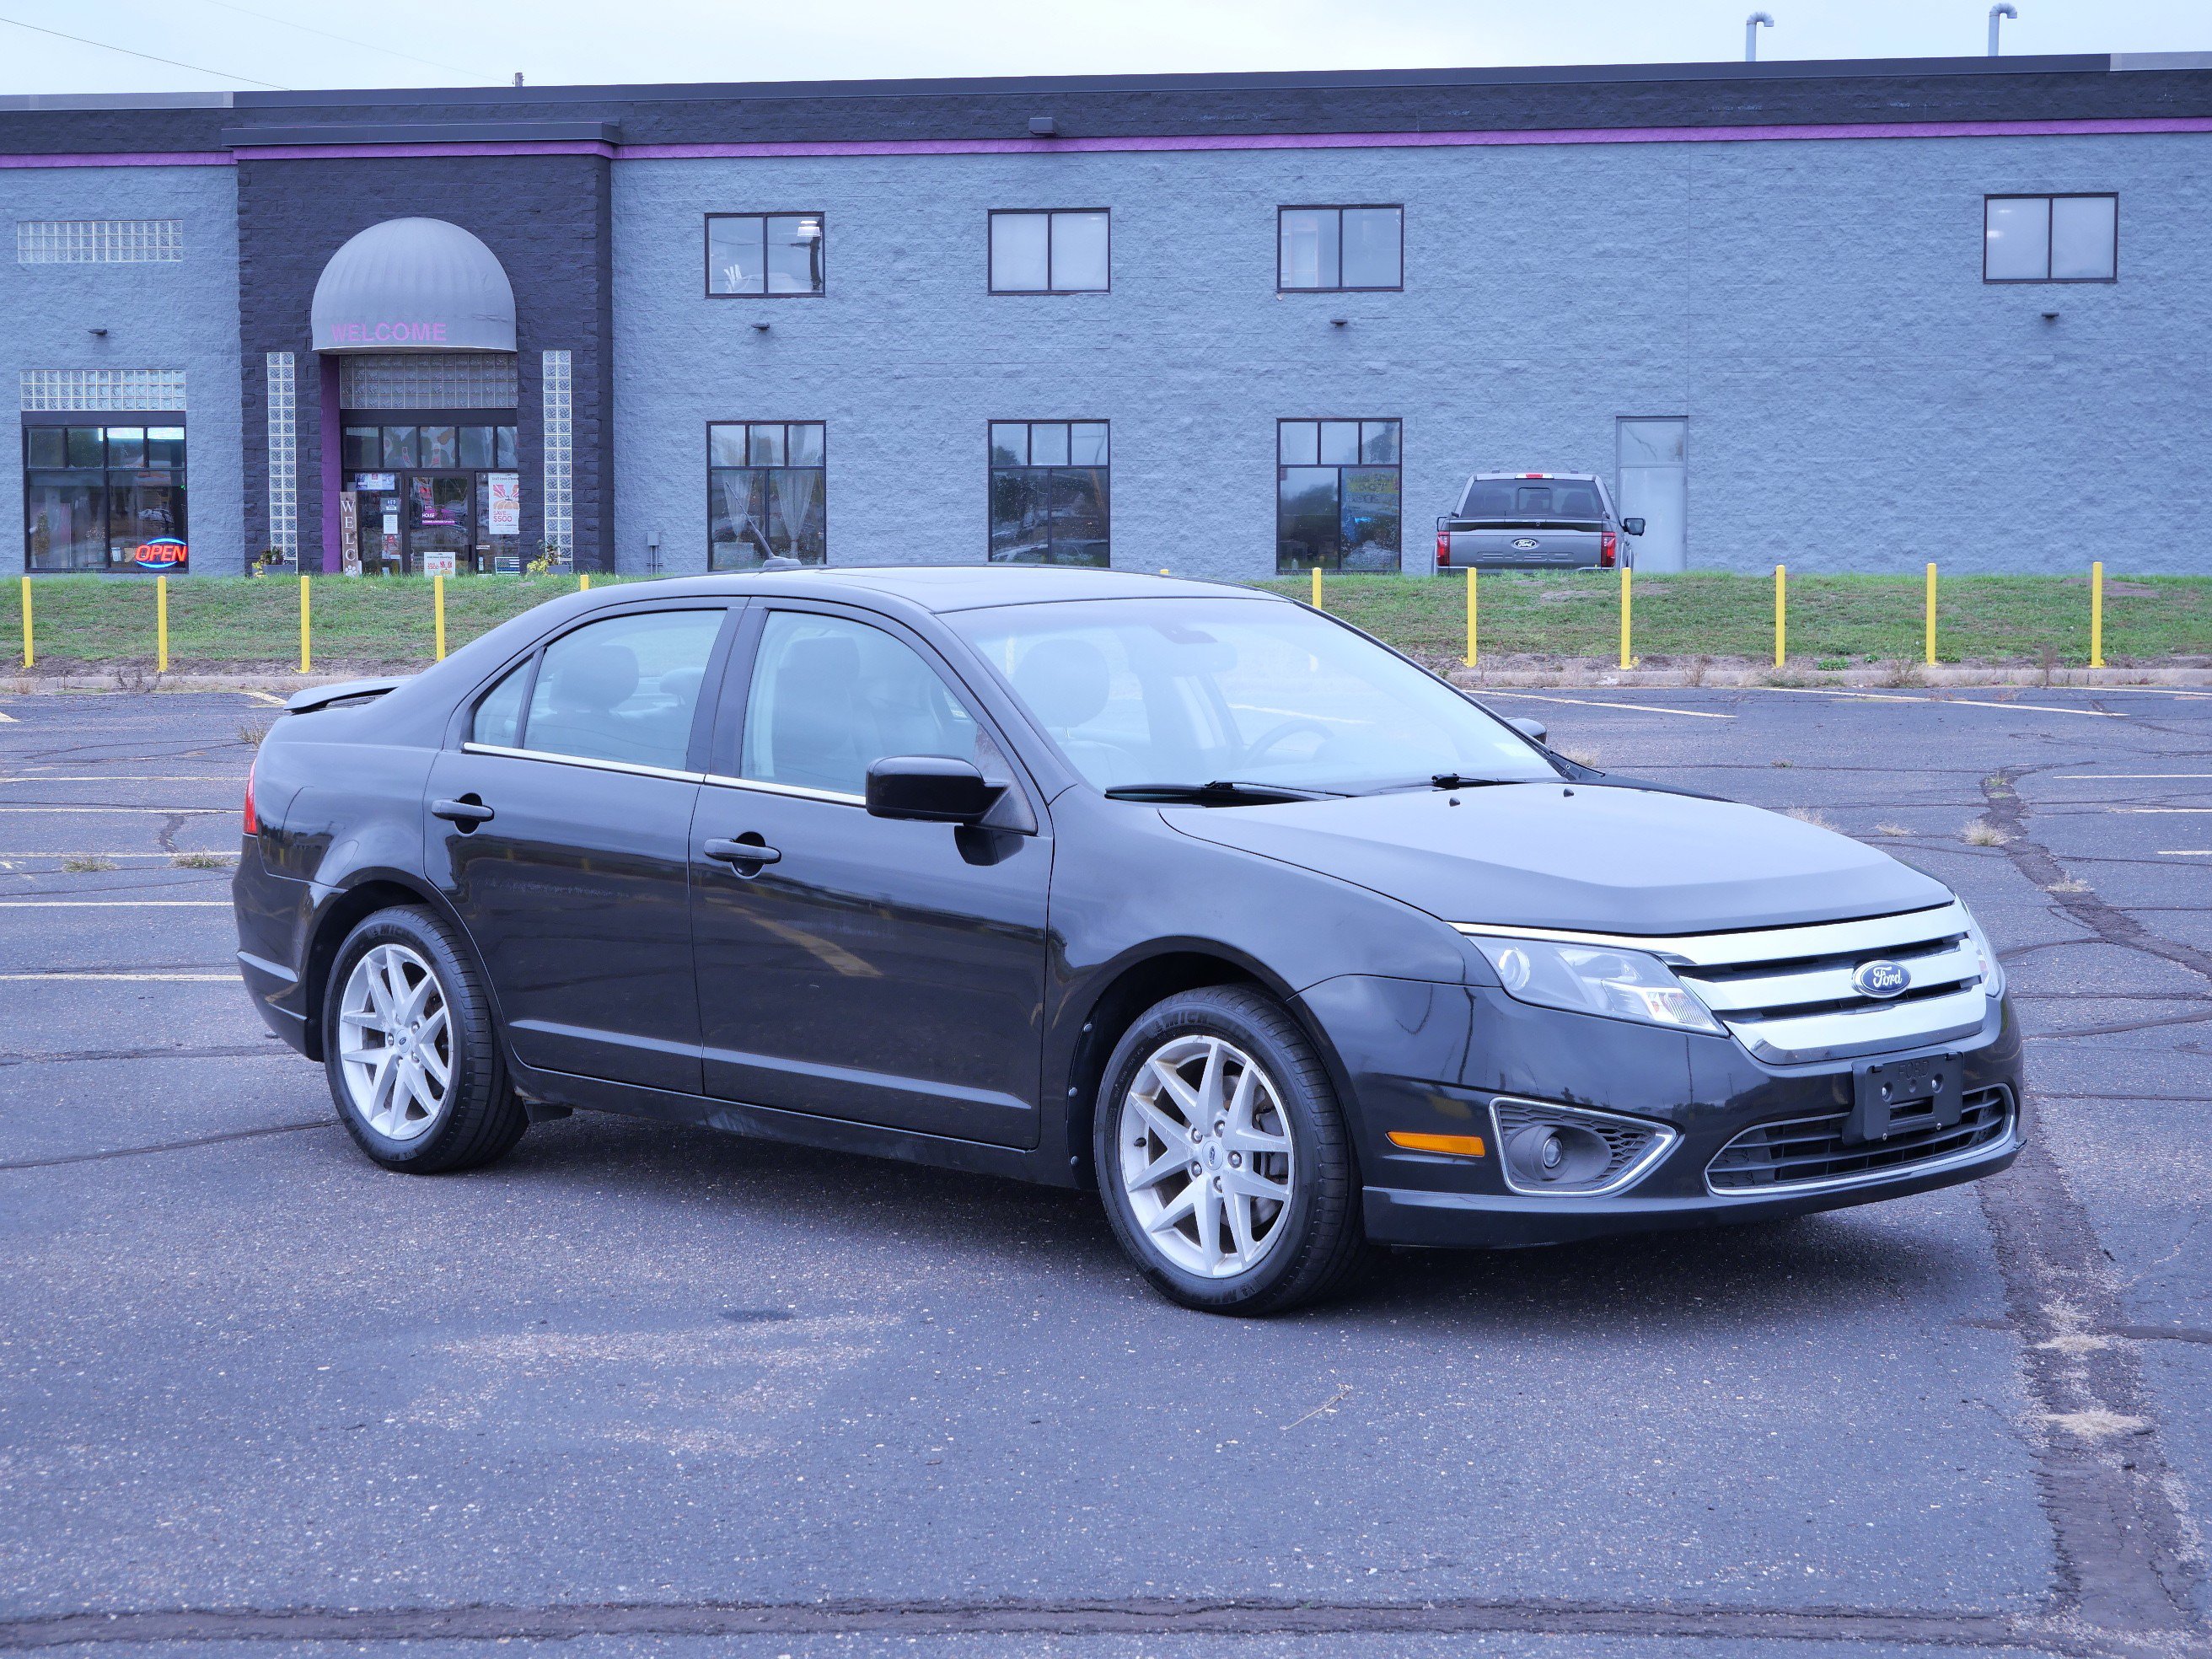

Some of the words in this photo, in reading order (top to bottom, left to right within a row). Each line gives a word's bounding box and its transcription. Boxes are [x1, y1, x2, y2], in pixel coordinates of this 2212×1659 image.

[330, 322, 447, 341] WELCOME
[135, 544, 188, 562] OPEN
[1872, 966, 1903, 988] Ford
[1898, 1057, 1930, 1082] FORD
